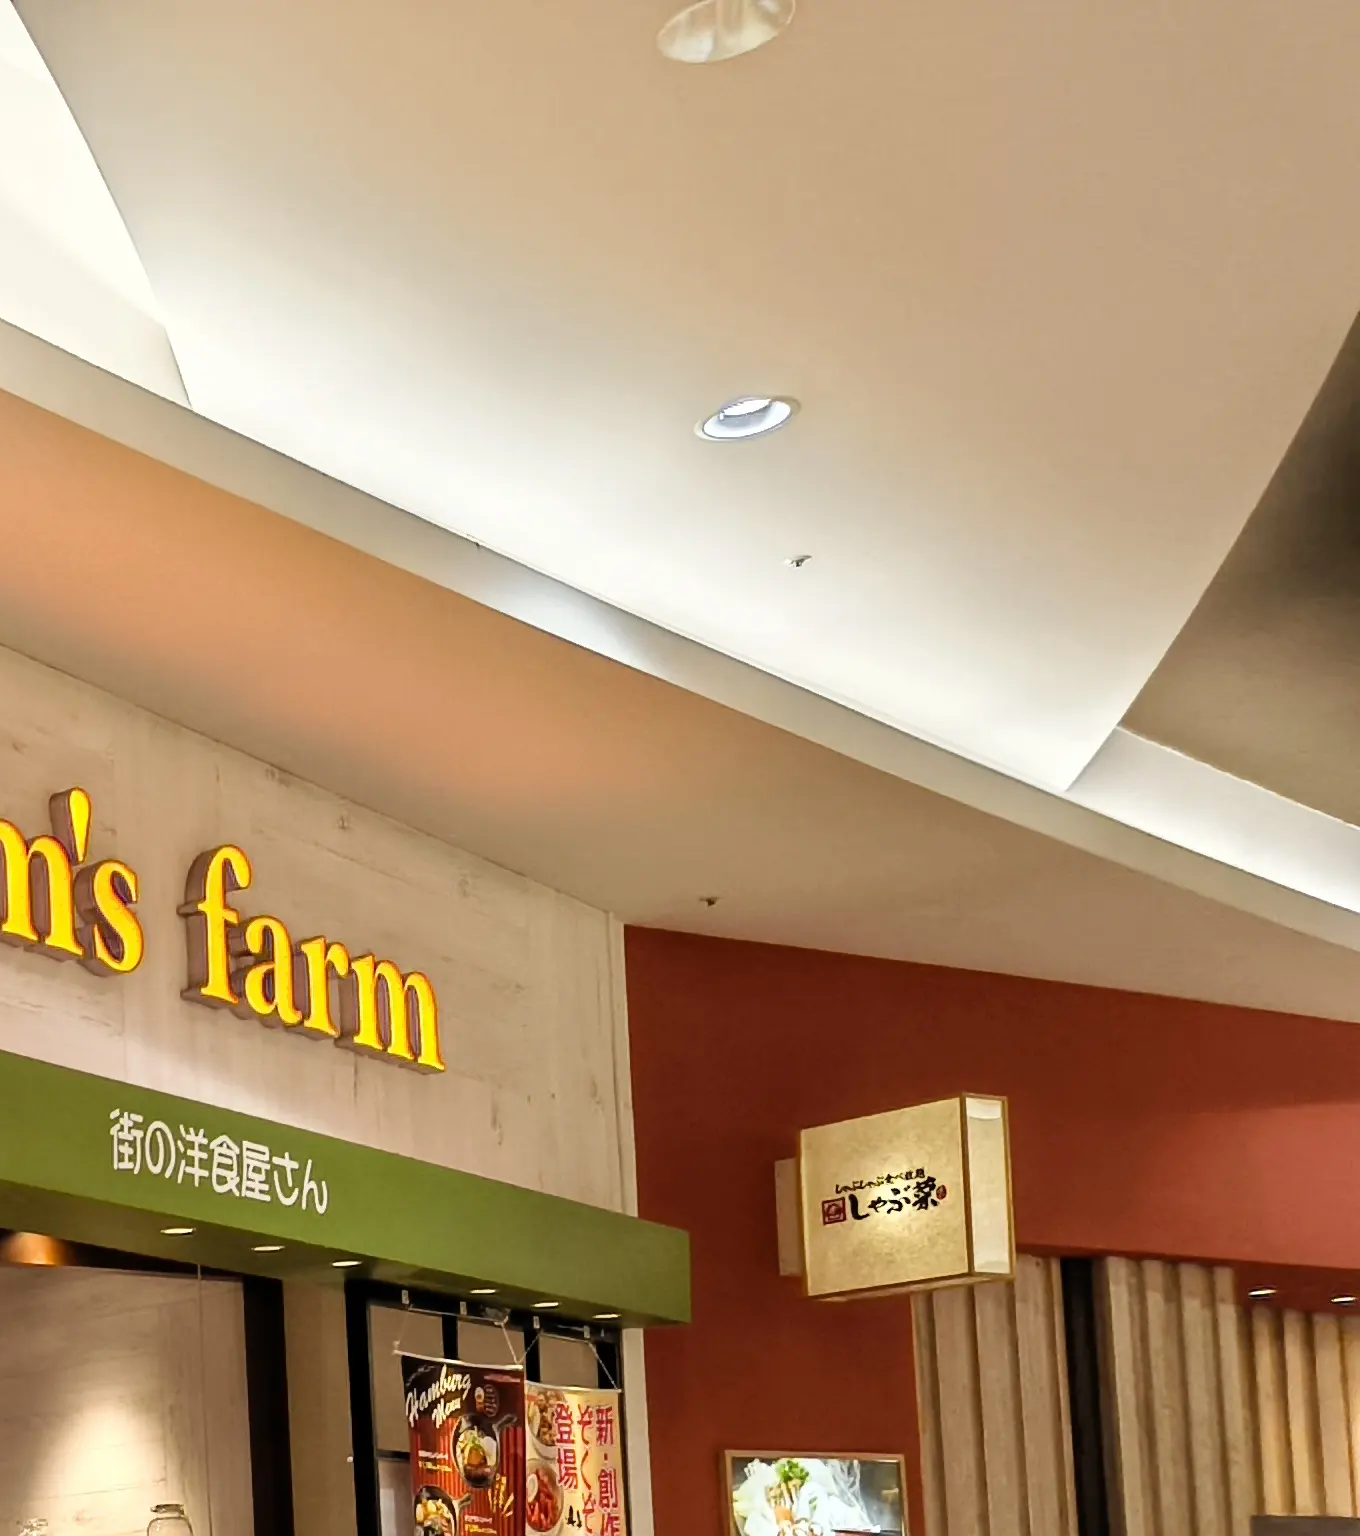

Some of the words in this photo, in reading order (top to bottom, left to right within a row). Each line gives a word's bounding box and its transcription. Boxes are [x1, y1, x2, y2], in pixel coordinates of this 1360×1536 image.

[178, 844, 446, 1075] farm
[109, 1108, 328, 1214] 街の洋食屋さん
[835, 1167, 926, 1195] しゃぶしゃぶ食べ放題
[848, 1176, 940, 1221] しゃぶ菜
[405, 1363, 472, 1428] Hamburg
